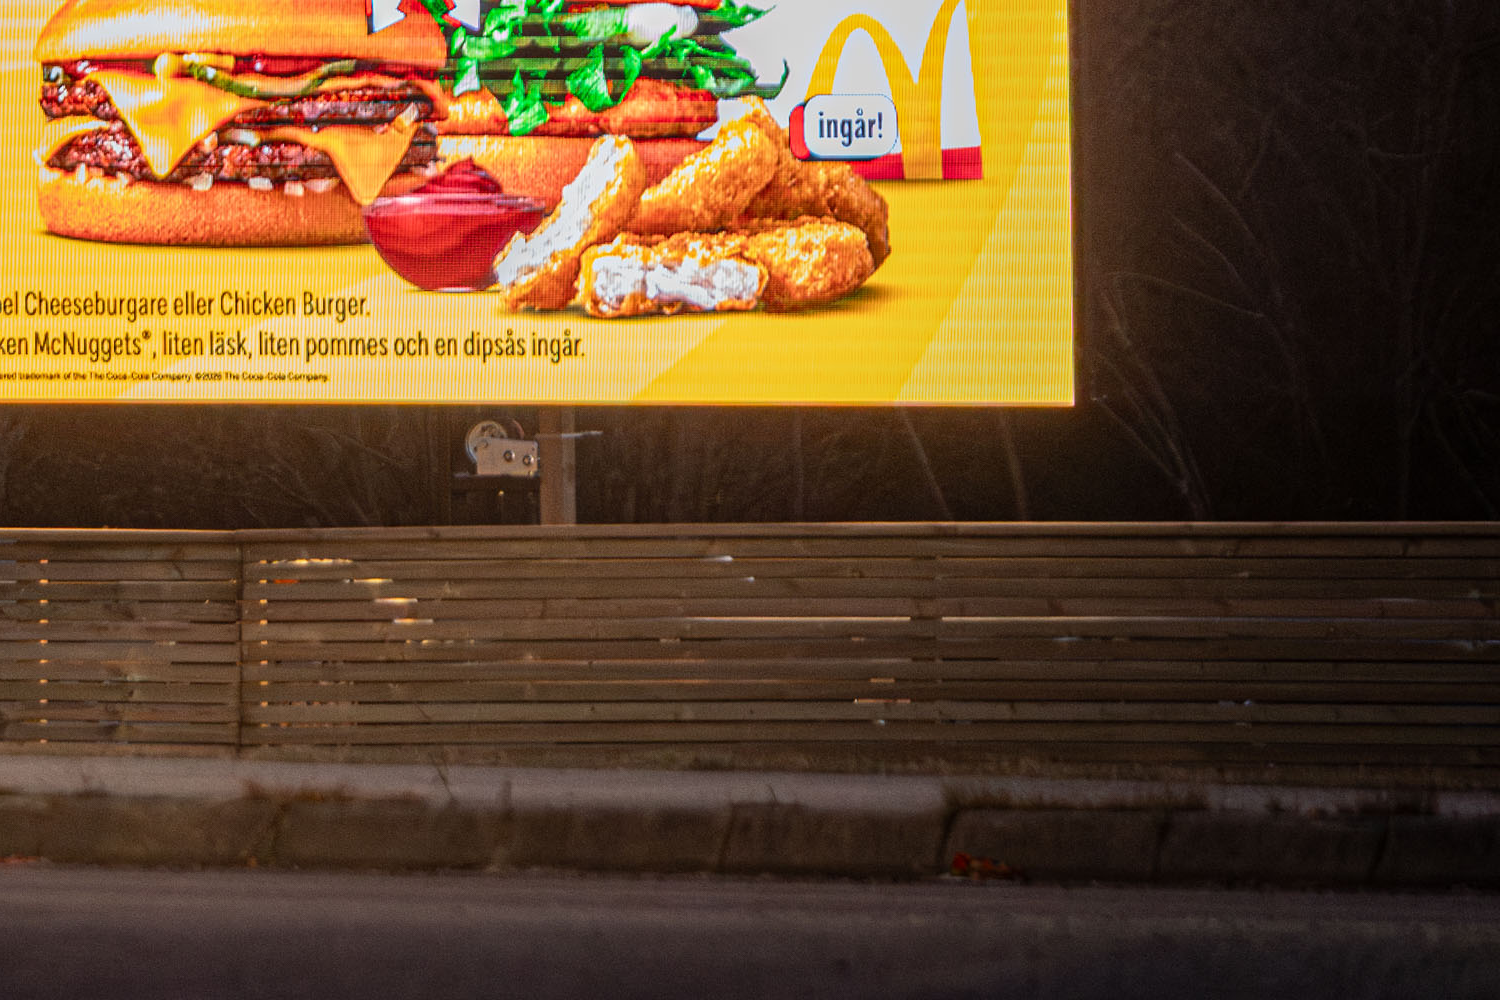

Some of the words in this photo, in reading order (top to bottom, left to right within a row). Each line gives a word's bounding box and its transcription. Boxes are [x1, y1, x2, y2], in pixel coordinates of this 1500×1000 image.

[818, 107, 883, 147] ingår!
[24, 290, 167, 323] Cheeseburgare
[173, 291, 214, 316] eller
[220, 290, 295, 316] Chicken
[303, 291, 371, 323] Burger.
[163, 331, 204, 356] liten
[209, 331, 252, 360] läsk,
[258, 331, 300, 356] liten
[306, 336, 388, 363] pommes
[394, 331, 429, 356] och
[434, 336, 457, 356] en
[463, 329, 526, 363] dipsås
[532, 329, 585, 364] ingår.
